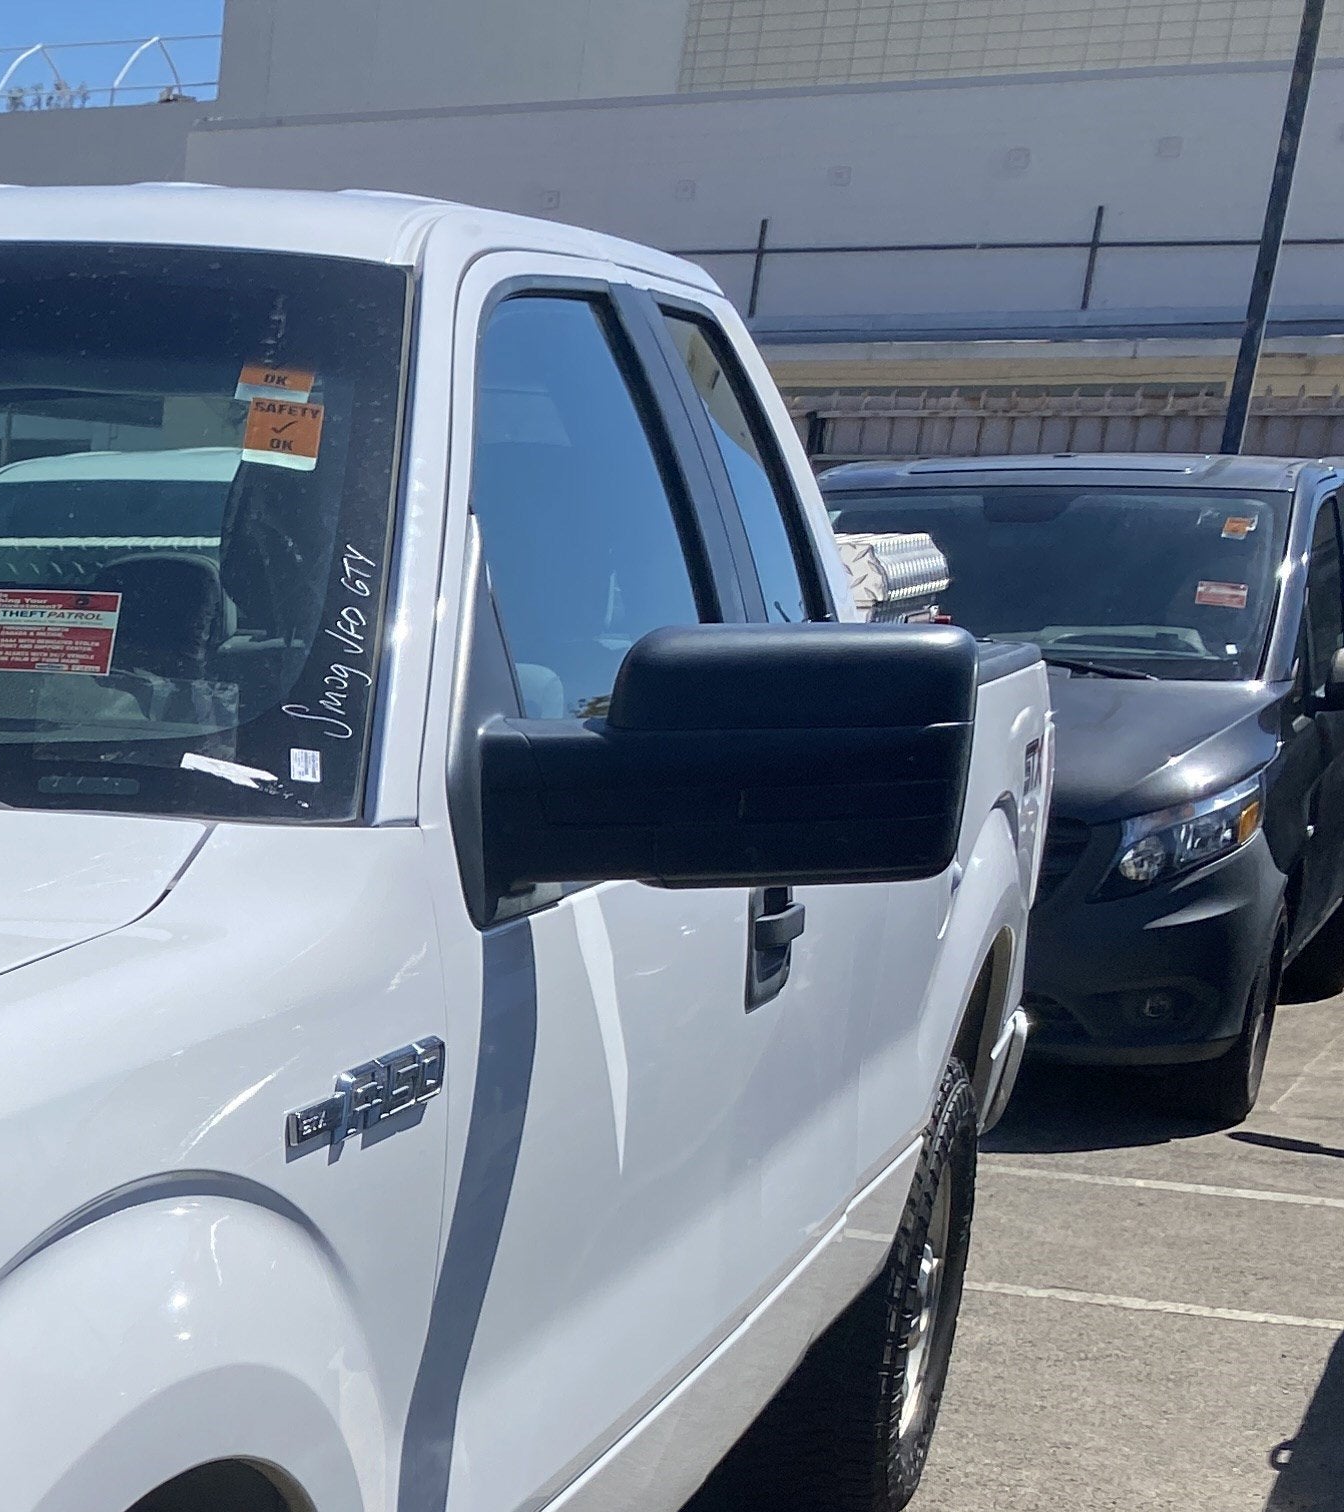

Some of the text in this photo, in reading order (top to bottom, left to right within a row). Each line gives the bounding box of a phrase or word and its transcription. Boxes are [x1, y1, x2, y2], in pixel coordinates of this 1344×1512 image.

[263, 373, 288, 386] OK
[254, 402, 321, 419] SAFETY
[269, 438, 294, 451] OK
